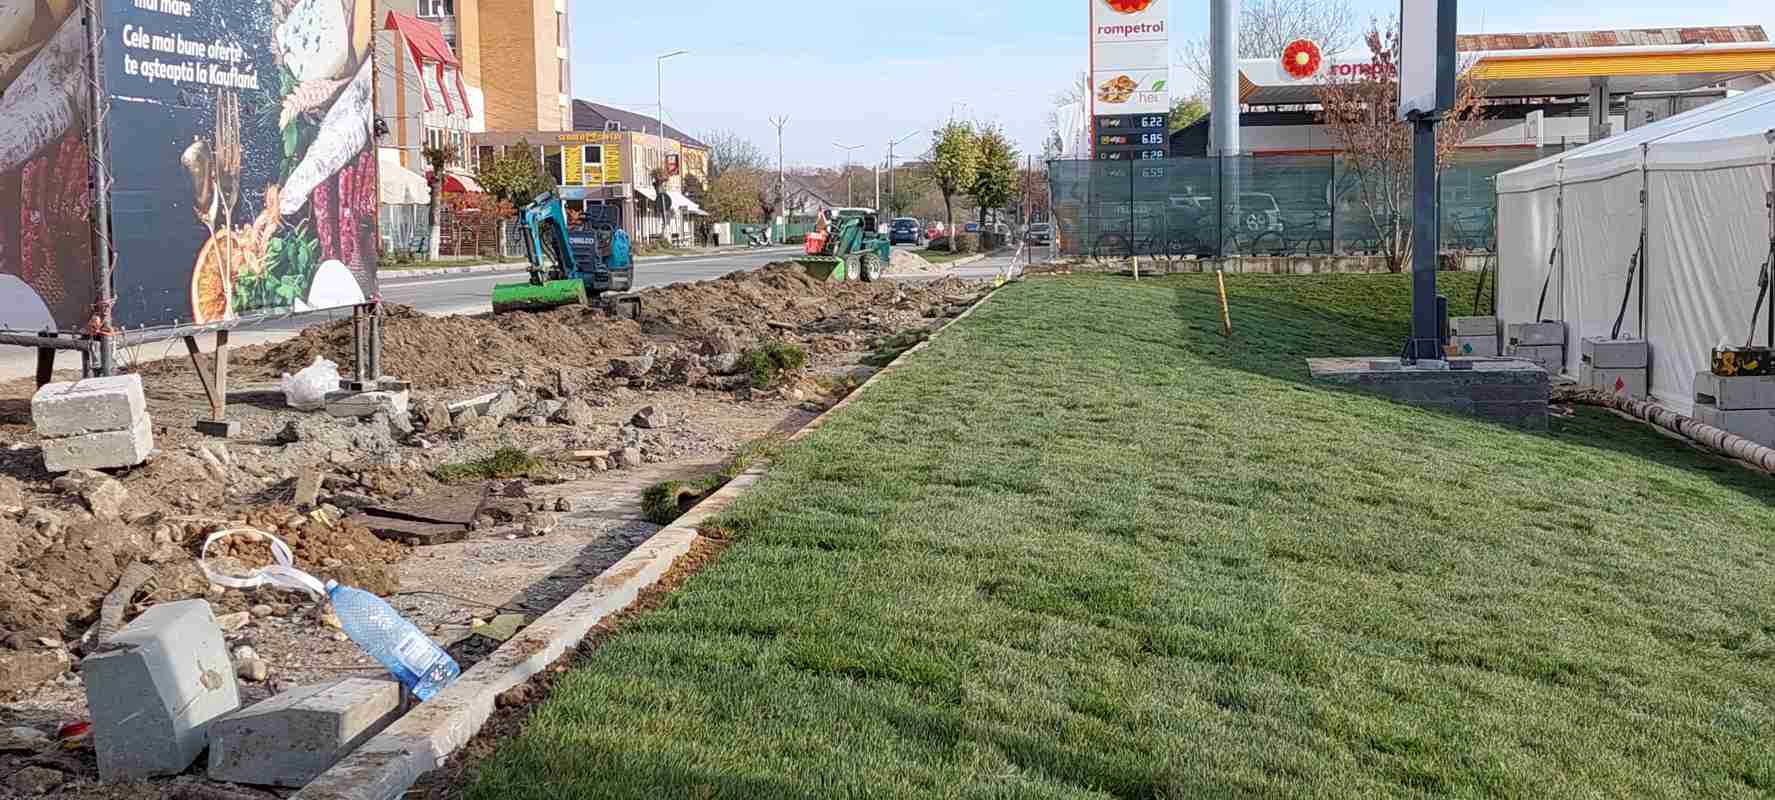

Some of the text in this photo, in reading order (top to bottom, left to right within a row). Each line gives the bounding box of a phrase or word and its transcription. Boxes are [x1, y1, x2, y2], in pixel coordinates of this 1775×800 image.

[160, 0, 191, 17] mare
[1098, 20, 1164, 37] rompetrol
[123, 24, 150, 49] Cele
[152, 33, 175, 53] mai
[177, 33, 205, 57] bune
[124, 53, 138, 75] te
[141, 57, 194, 85] așteaptă
[196, 62, 208, 83] la
[1142, 117, 1163, 127] 6.22
[1142, 133, 1163, 144] 6.85
